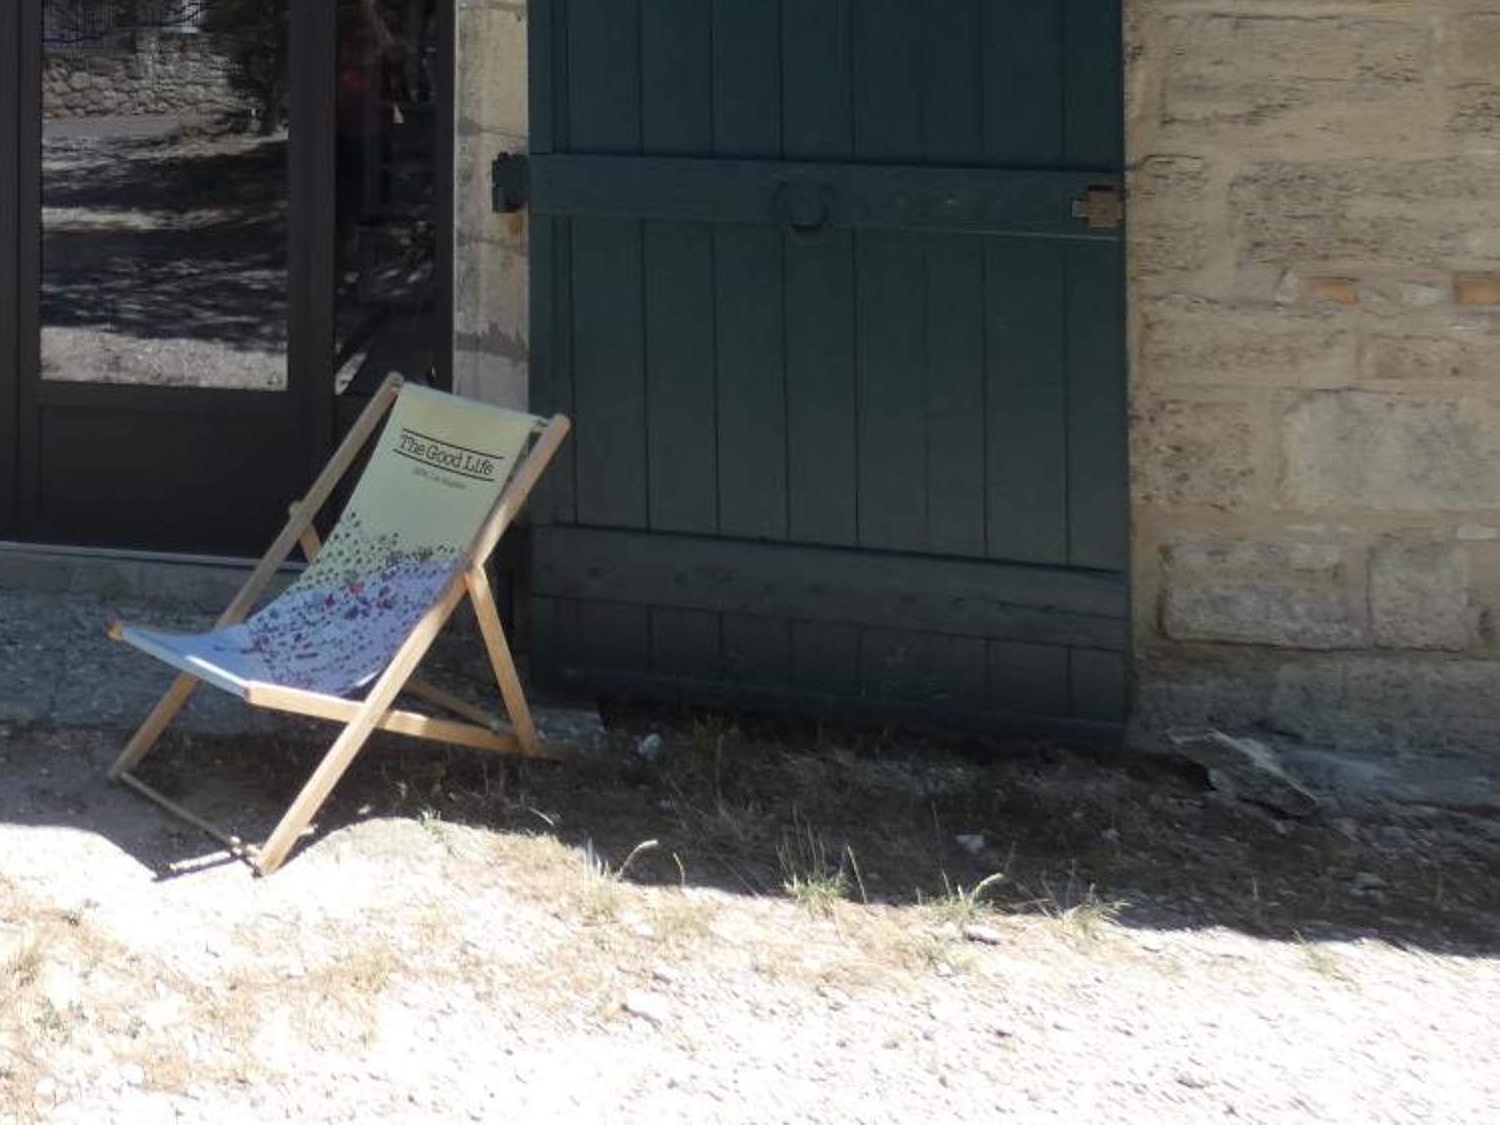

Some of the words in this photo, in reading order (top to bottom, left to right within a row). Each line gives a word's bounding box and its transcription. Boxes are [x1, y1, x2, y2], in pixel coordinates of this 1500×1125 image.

[401, 435, 425, 456] The
[426, 445, 463, 467] Good
[463, 456, 494, 476] Life
